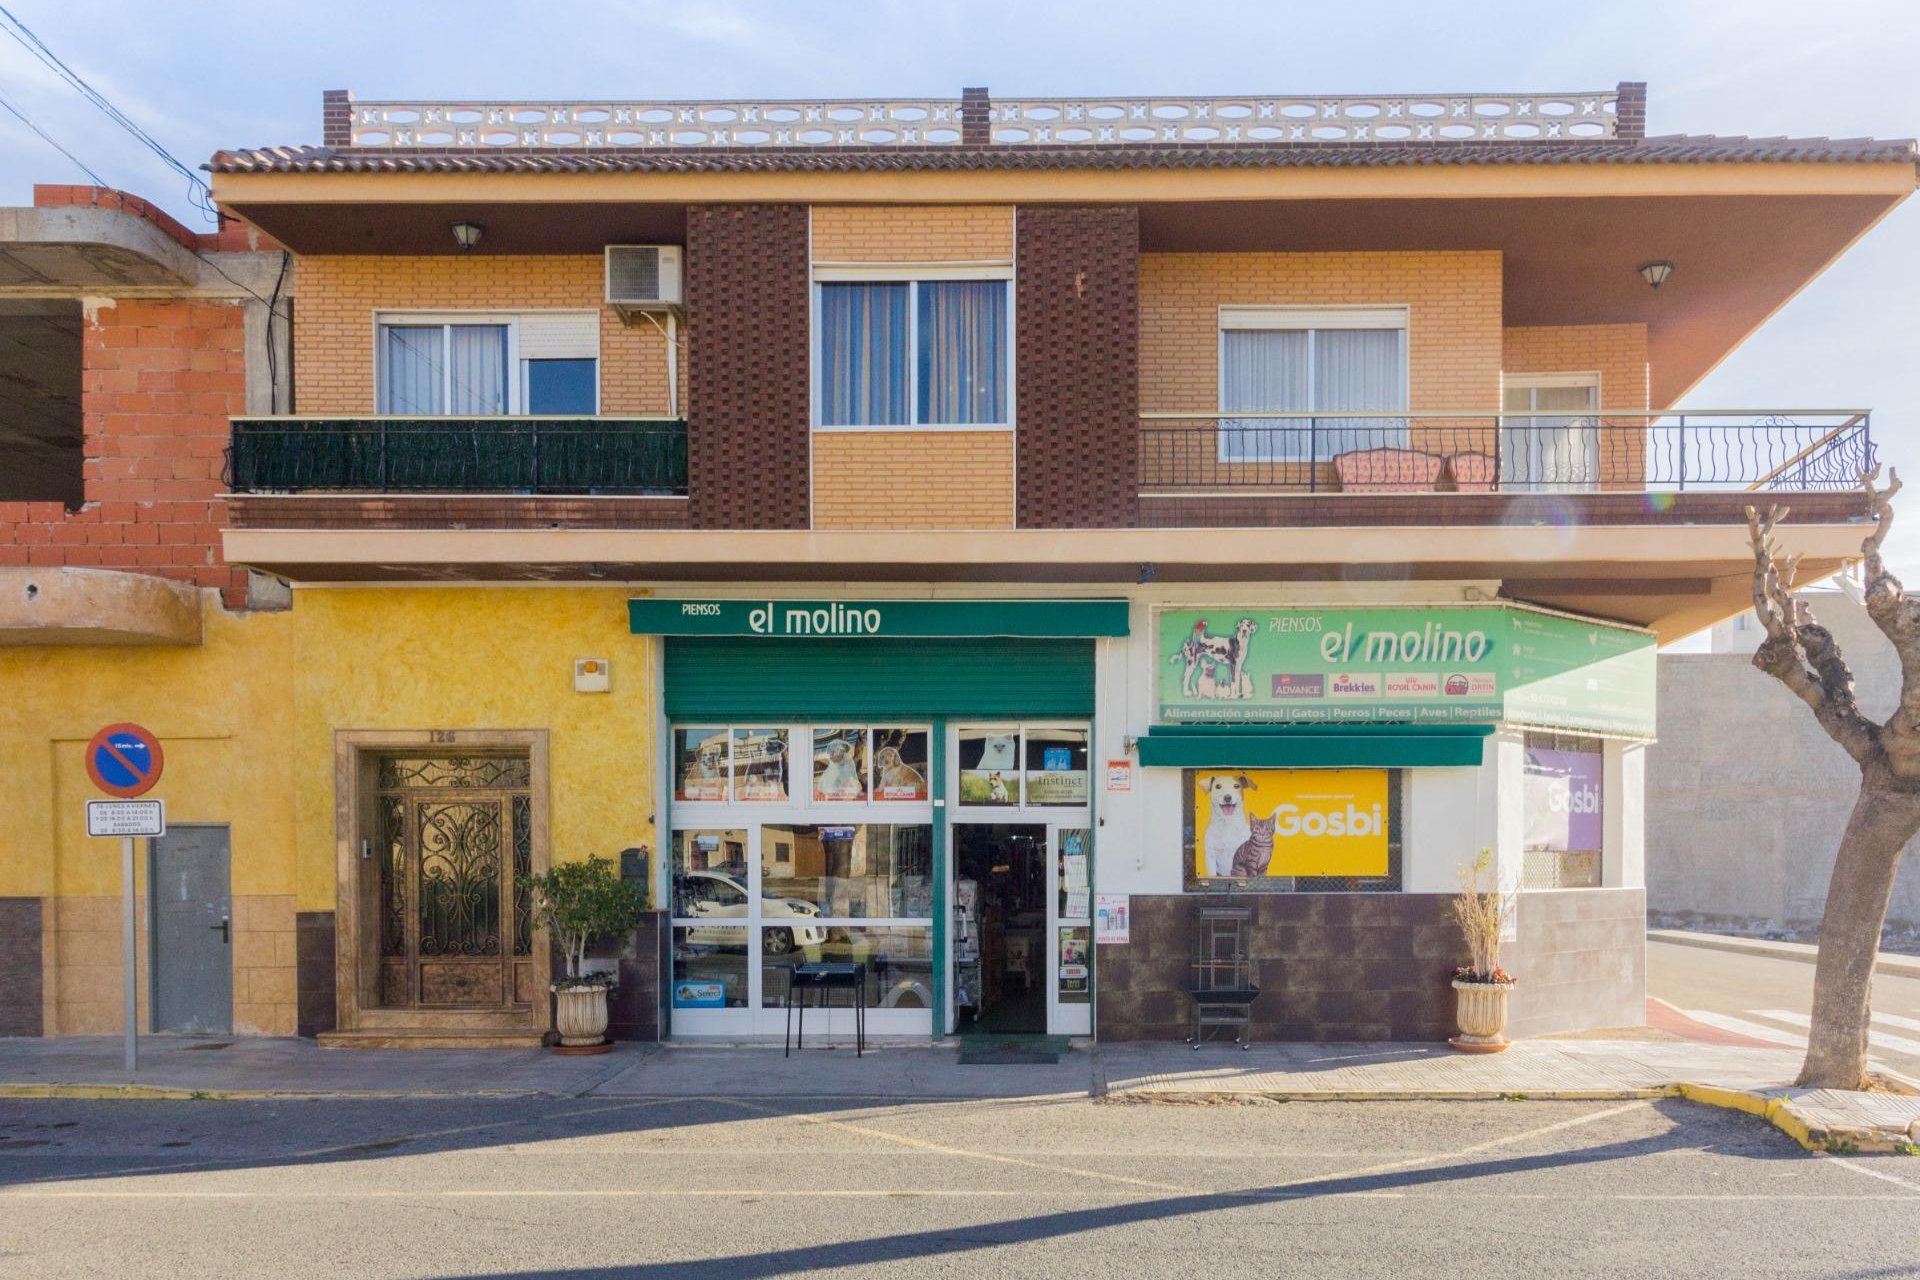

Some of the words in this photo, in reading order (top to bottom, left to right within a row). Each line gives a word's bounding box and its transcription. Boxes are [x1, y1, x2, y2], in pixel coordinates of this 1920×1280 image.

[682, 603, 721, 615] PIENSOS
[749, 602, 774, 634] el
[786, 602, 881, 634] molino
[1269, 617, 1322, 632] PIENSOS
[1319, 622, 1353, 663] el
[1364, 621, 1486, 663] molino
[1275, 685, 1321, 695] ADVANCE
[1333, 682, 1375, 692] Brekkies
[1387, 683, 1410, 691] ROYAL
[1412, 683, 1437, 691] CANIN
[1164, 707, 1242, 718] Alimentación
[1244, 707, 1283, 718] animal
[1291, 708, 1326, 718] Gatos
[1333, 708, 1370, 718] Perros
[1379, 707, 1411, 717] Peces
[1420, 707, 1448, 717] Aves
[1455, 707, 1501, 719] Reptiles
[1548, 782, 1599, 814] Gosbi
[1274, 803, 1382, 837] Gosbi
